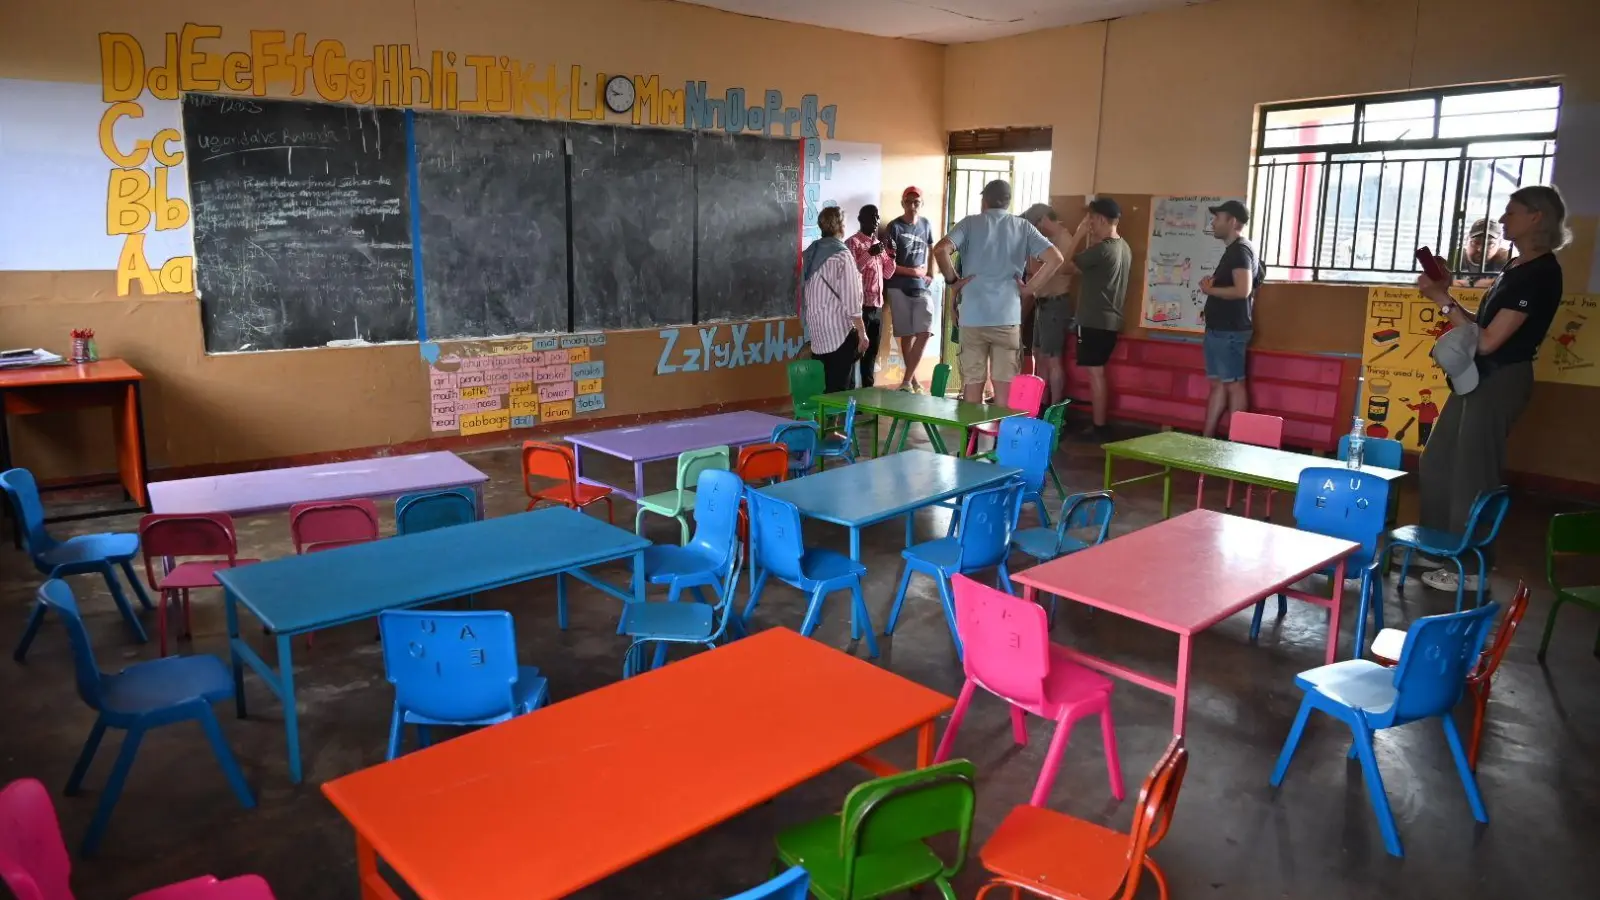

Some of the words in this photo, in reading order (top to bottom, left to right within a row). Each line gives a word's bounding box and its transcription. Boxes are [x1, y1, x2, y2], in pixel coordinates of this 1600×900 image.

[1419, 308, 1434, 323] a
[1322, 478, 1335, 491] A
[1349, 478, 1361, 491] U
